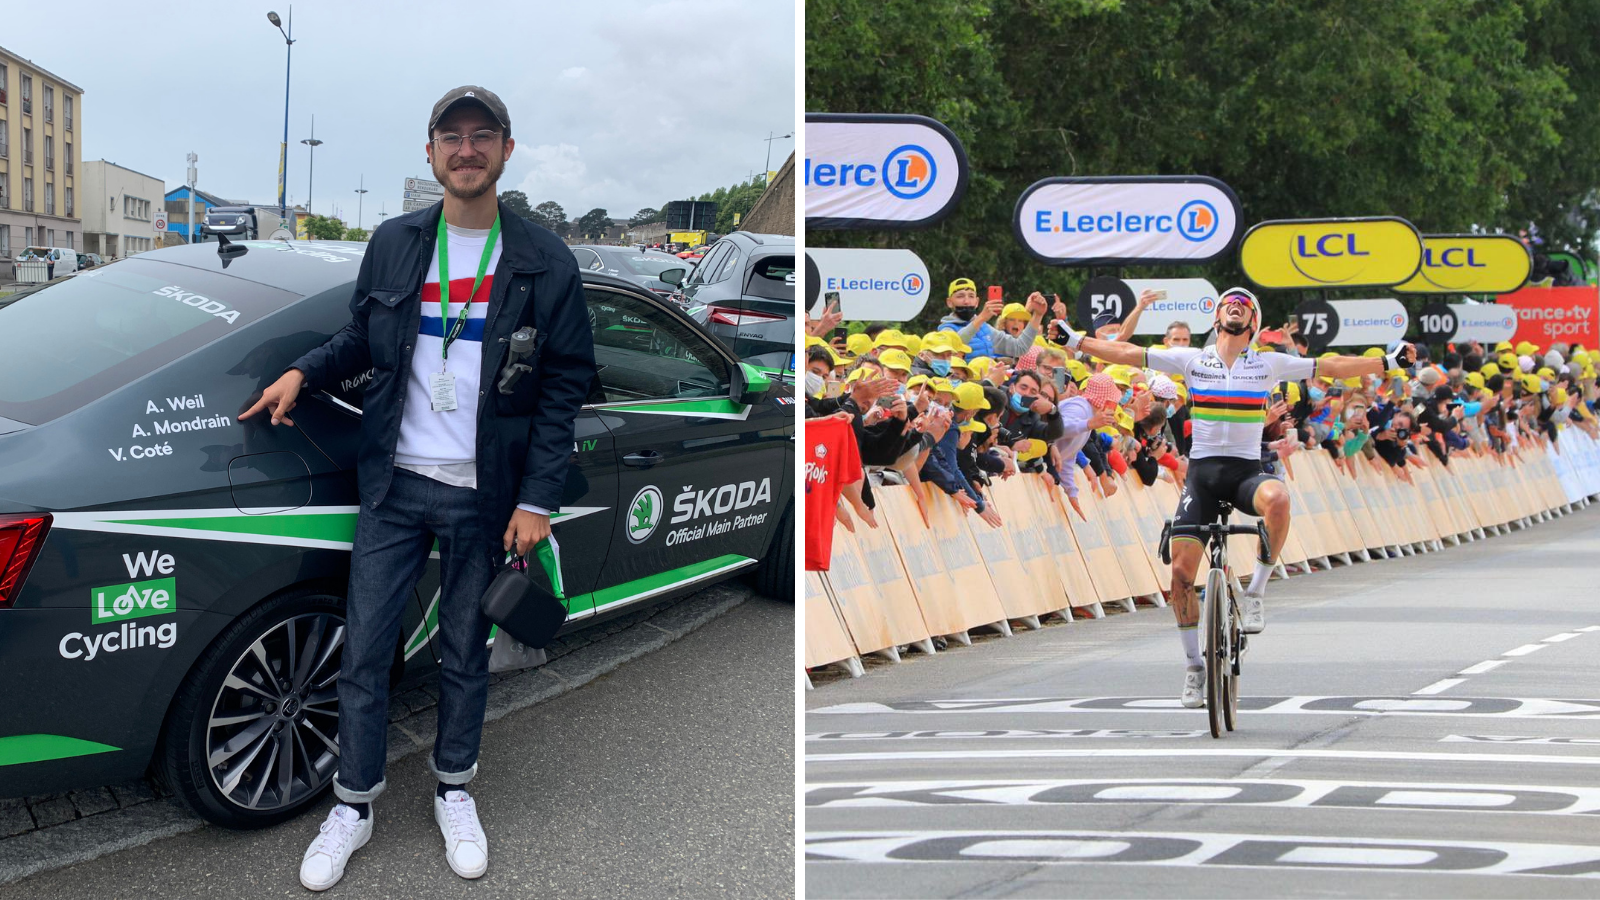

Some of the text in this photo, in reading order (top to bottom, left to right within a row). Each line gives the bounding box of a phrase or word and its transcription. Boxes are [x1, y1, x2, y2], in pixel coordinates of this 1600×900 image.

[1035, 210, 1173, 234] E.Leclerc
[1297, 233, 1370, 258] LCL
[1425, 248, 1486, 268] LCL
[827, 277, 900, 292] E.Leclerc
[152, 285, 241, 325] ŠKODA
[1091, 294, 1122, 320] 50
[1302, 313, 1328, 336] 75
[1343, 317, 1390, 327] E.Leclerc
[1420, 314, 1454, 334] 100
[1462, 319, 1500, 328] E.Leclerc
[1544, 321, 1590, 339] sport
[739, 332, 764, 340] ENYAQ
[145, 394, 205, 415] A. Weil
[132, 413, 231, 438] A. Mondrain
[108, 441, 173, 462] V. Coté
[582, 439, 598, 452] iV
[670, 477, 771, 525] ŠKODA
[665, 511, 768, 547] Official Main Partner
[122, 549, 175, 579] We
[97, 585, 170, 619] Love
[58, 622, 177, 661] Cycling
